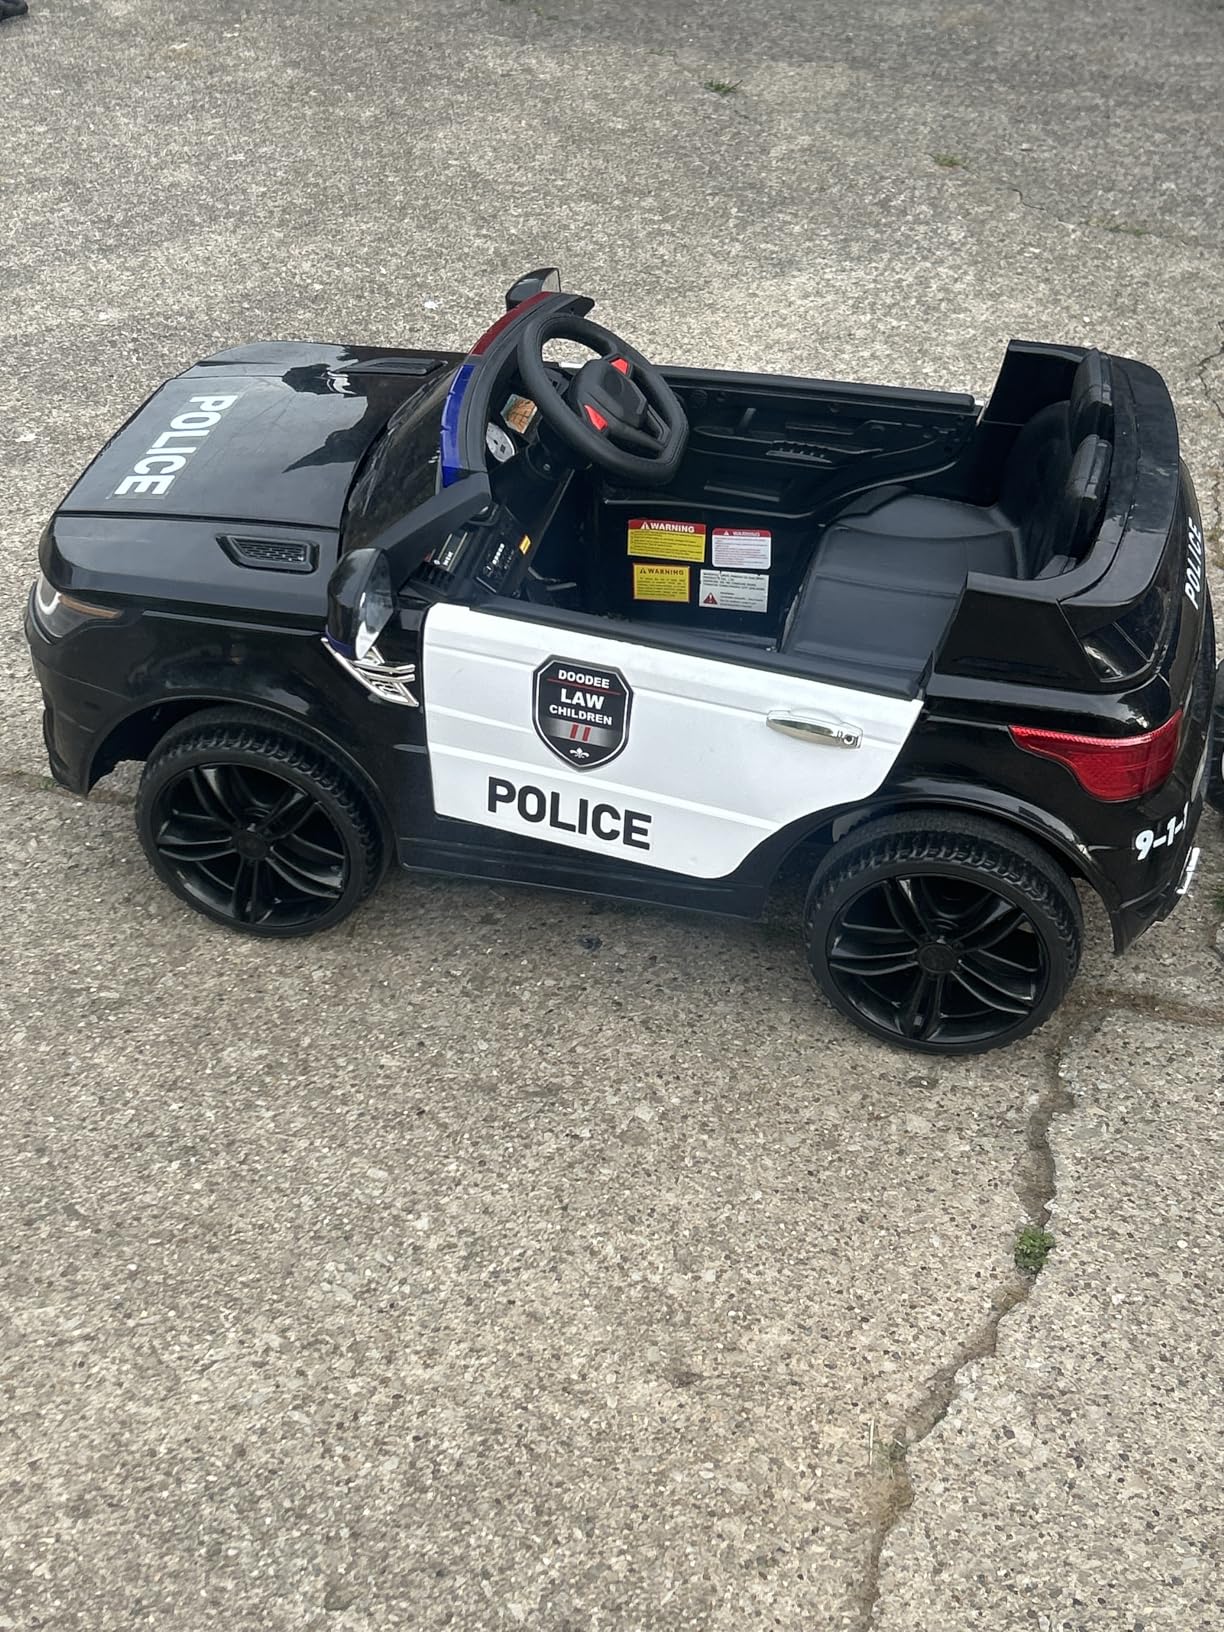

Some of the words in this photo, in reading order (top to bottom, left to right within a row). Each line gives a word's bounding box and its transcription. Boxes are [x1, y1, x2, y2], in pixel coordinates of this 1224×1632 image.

[114, 395, 238, 494] POLICE
[650, 522, 695, 533] WARNING
[647, 568, 684, 576] WARNING
[1185, 516, 1202, 610] POLICE
[558, 669, 610, 689] DOODEE
[560, 688, 605, 710] LAW
[549, 704, 612, 726] CHILDREN
[487, 776, 652, 851] POLICE
